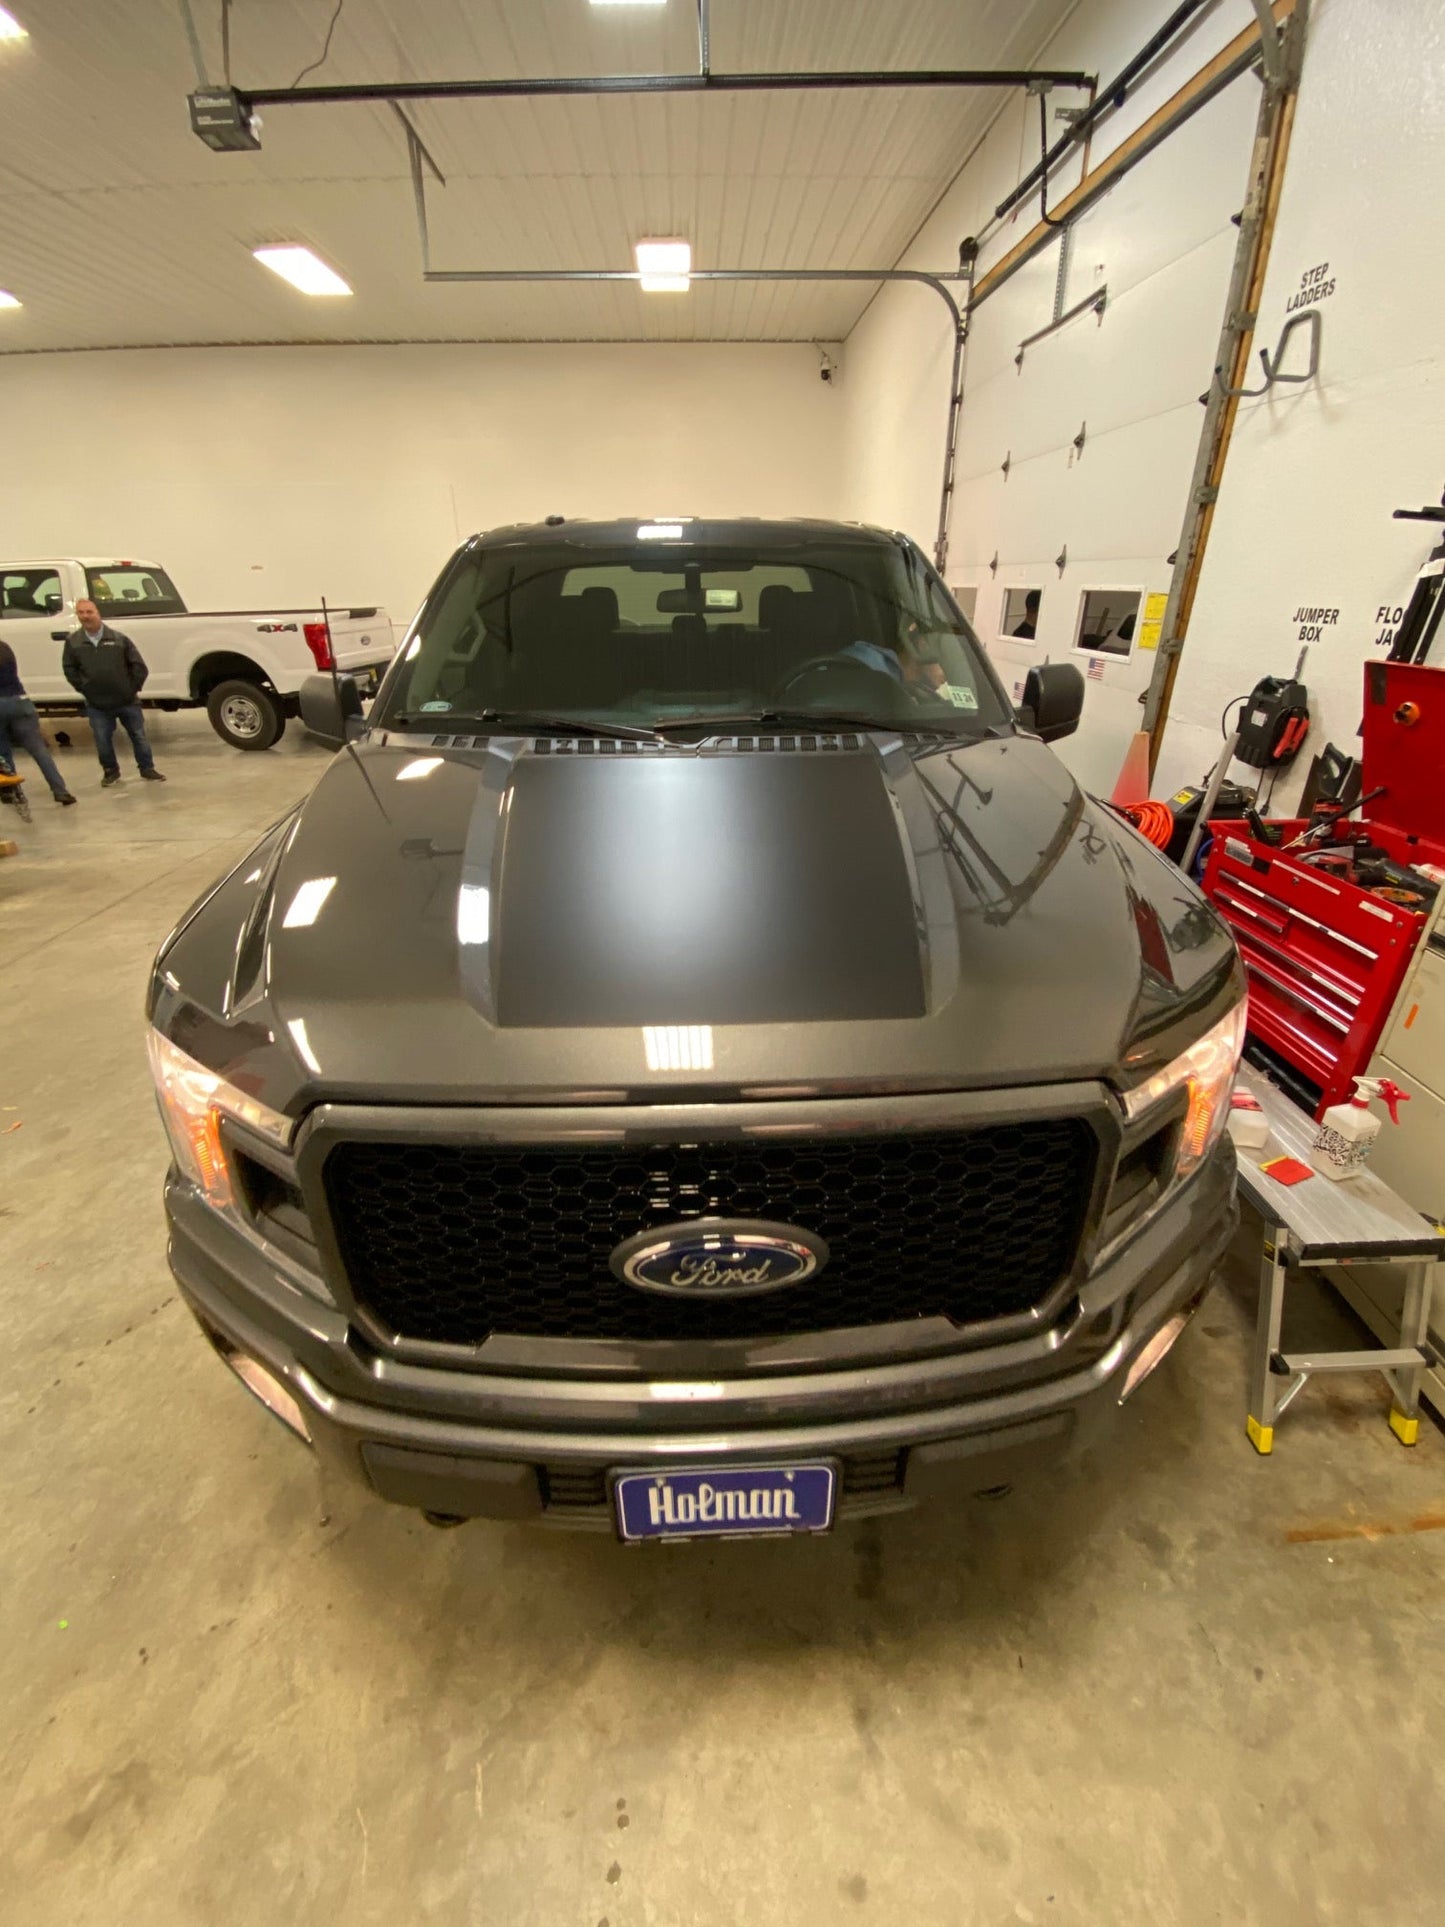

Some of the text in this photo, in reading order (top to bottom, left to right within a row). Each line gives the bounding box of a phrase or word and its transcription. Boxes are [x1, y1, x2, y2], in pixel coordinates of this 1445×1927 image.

[1301, 262, 1329, 289] STEP
[1286, 278, 1336, 313] LADDERS
[1293, 608, 1339, 625] JUMPER
[1375, 606, 1402, 624] FLO
[1298, 626, 1322, 642] BOX
[1375, 628, 1393, 646] JA
[671, 1252, 771, 1287] Ford
[648, 1483, 801, 1526] Holman
